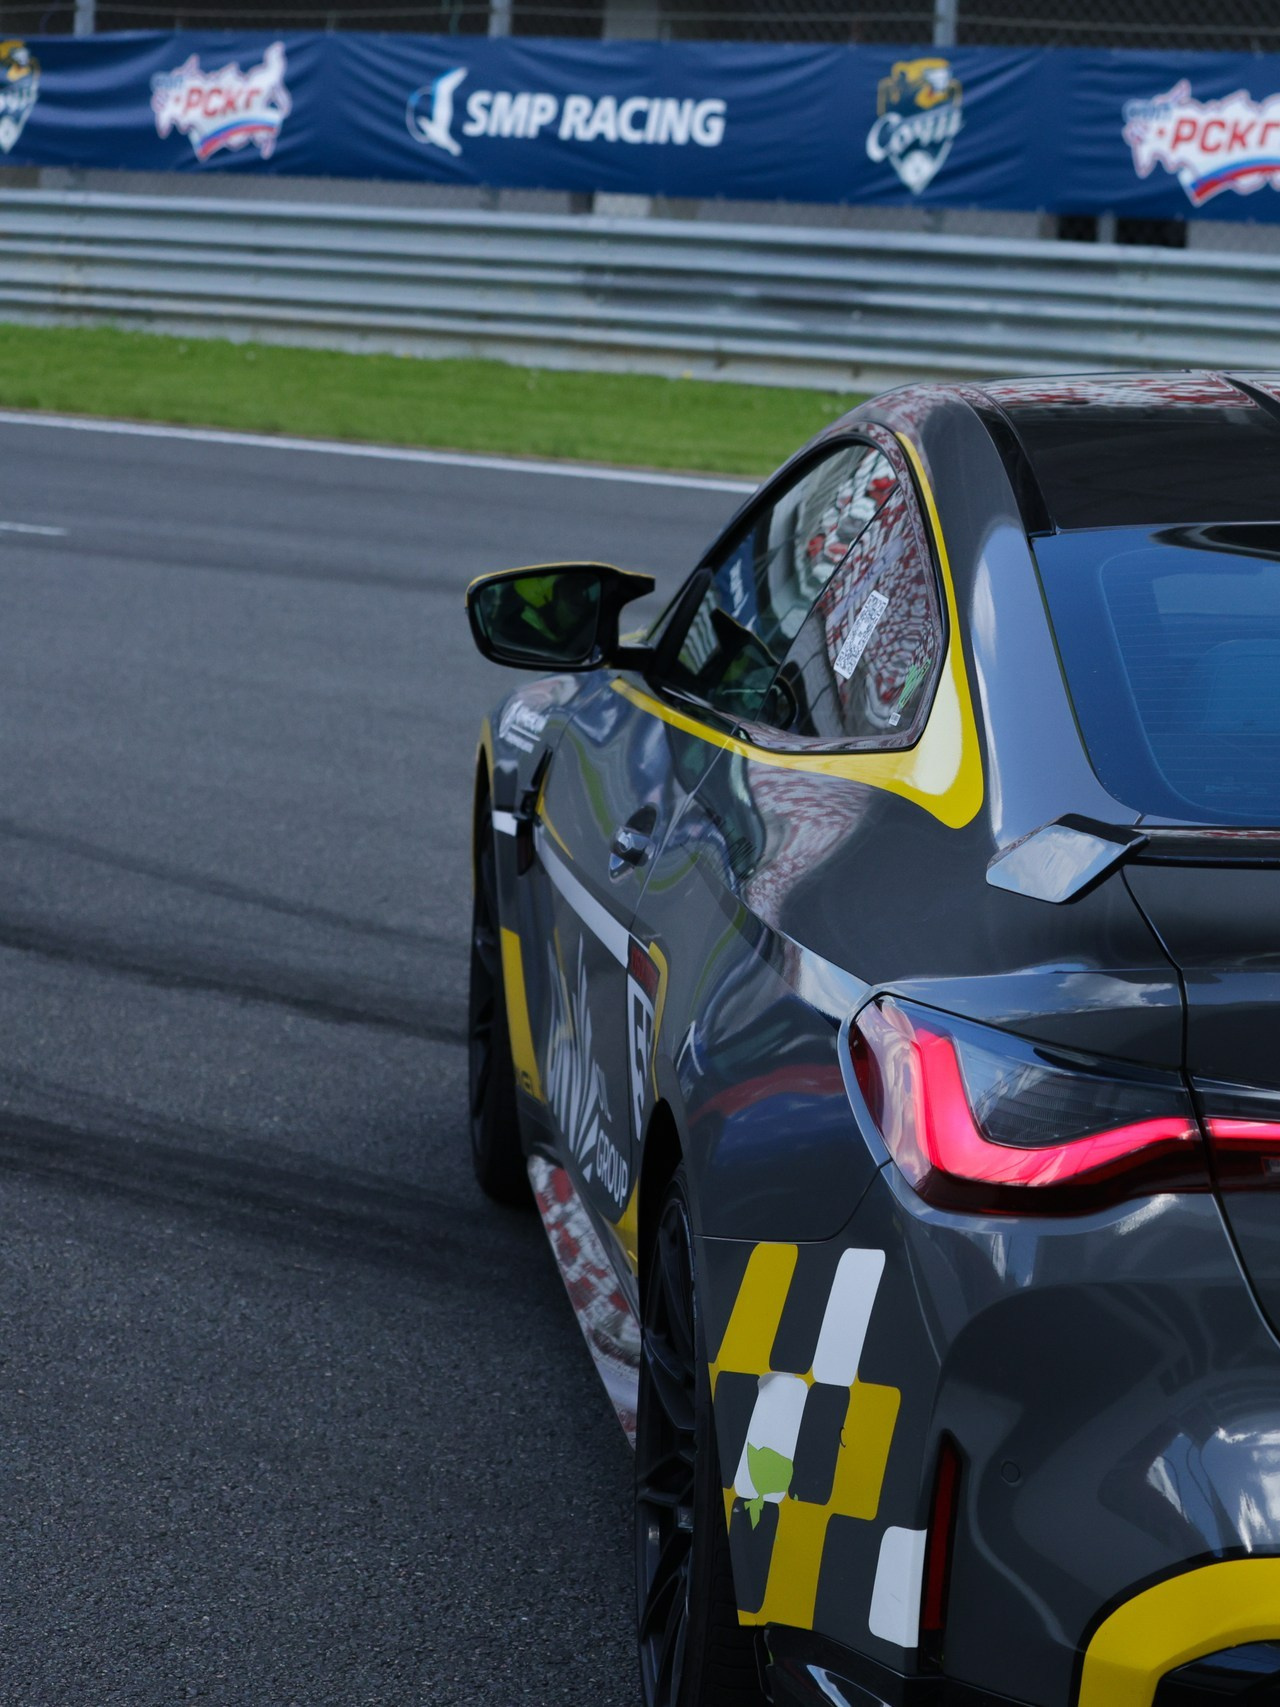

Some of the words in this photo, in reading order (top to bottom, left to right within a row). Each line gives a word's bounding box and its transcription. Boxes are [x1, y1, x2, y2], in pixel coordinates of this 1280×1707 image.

[183, 87, 262, 117] РСКГ
[463, 90, 556, 139] SMP
[558, 96, 727, 148] RACING
[596, 1128, 629, 1208] GROUP
